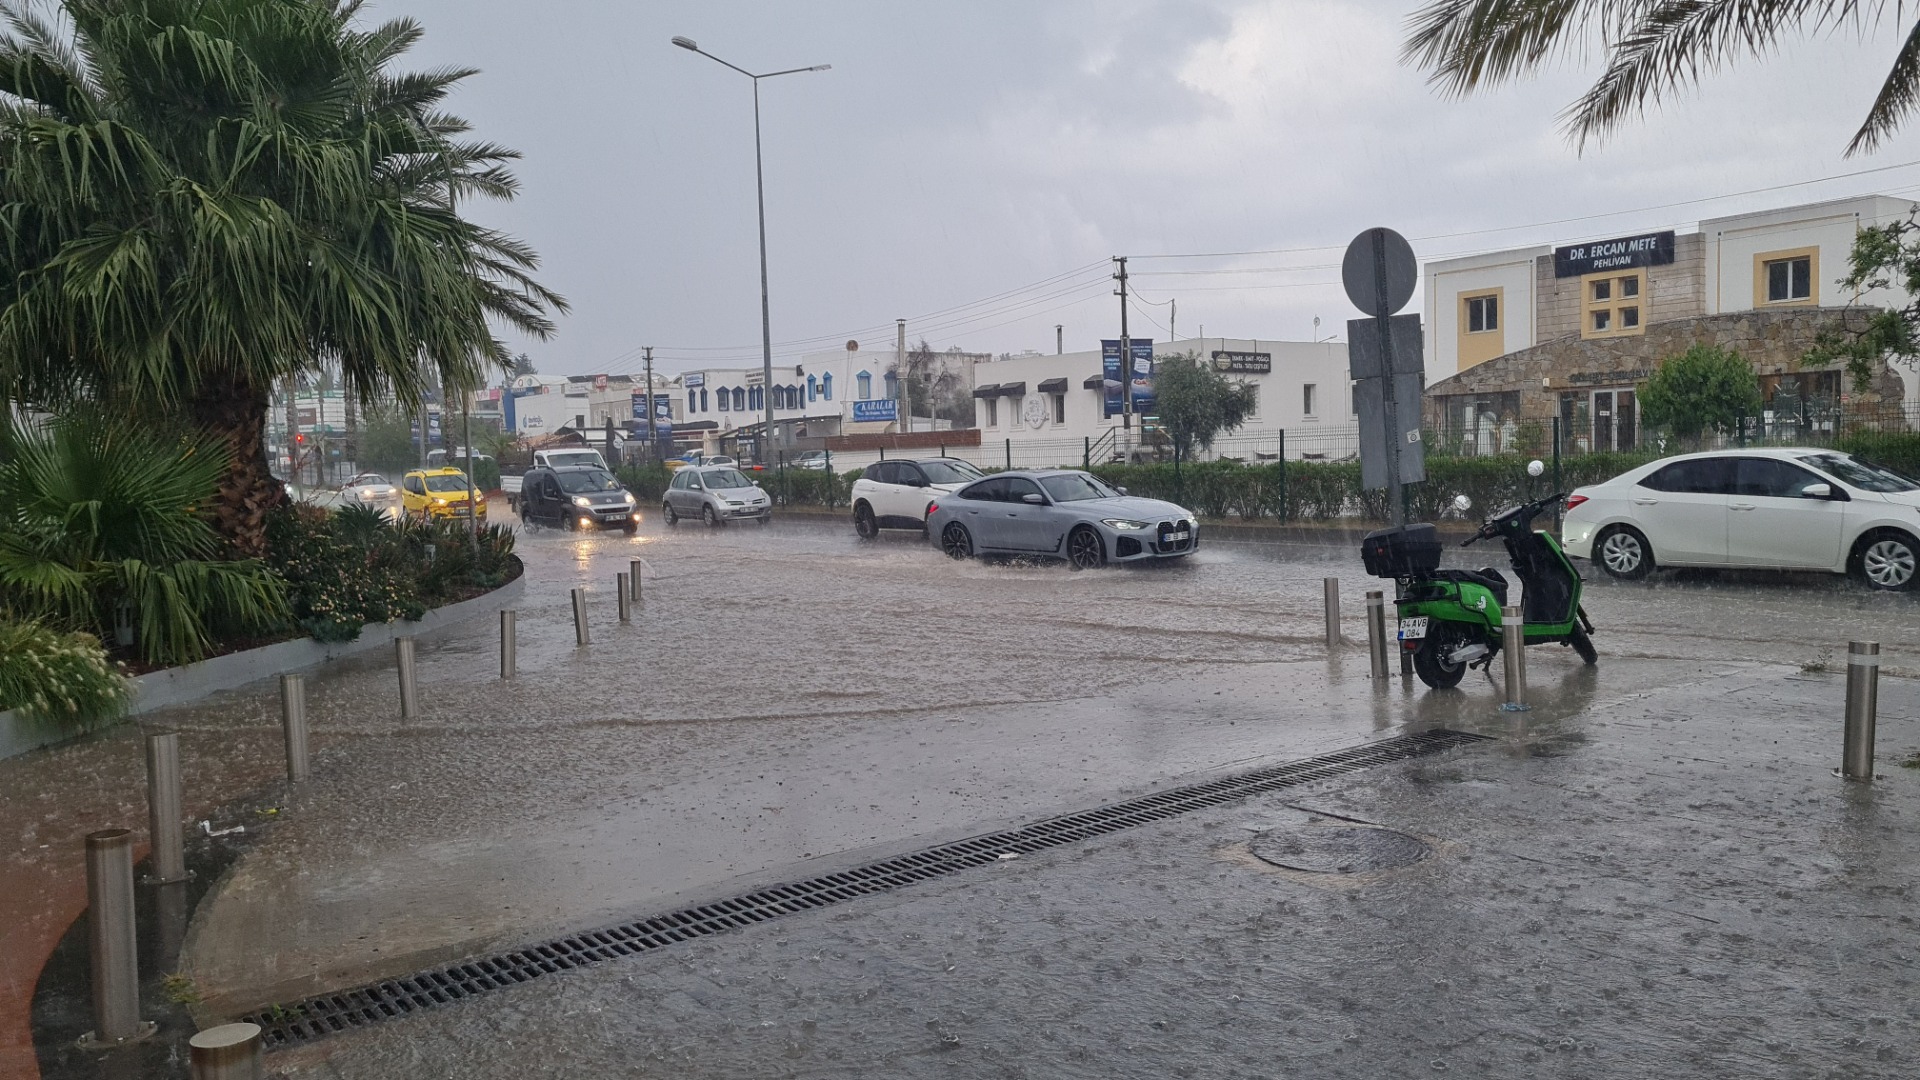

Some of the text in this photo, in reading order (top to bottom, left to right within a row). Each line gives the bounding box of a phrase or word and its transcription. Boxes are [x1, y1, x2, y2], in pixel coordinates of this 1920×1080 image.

[1569, 236, 1657, 261] DR. ERCAN METE
[1593, 255, 1632, 269] PEHLİVAN
[861, 400, 893, 411] KARALAR
[1401, 618, 1427, 629] 34 AVB
[1406, 628, 1420, 638] 084
